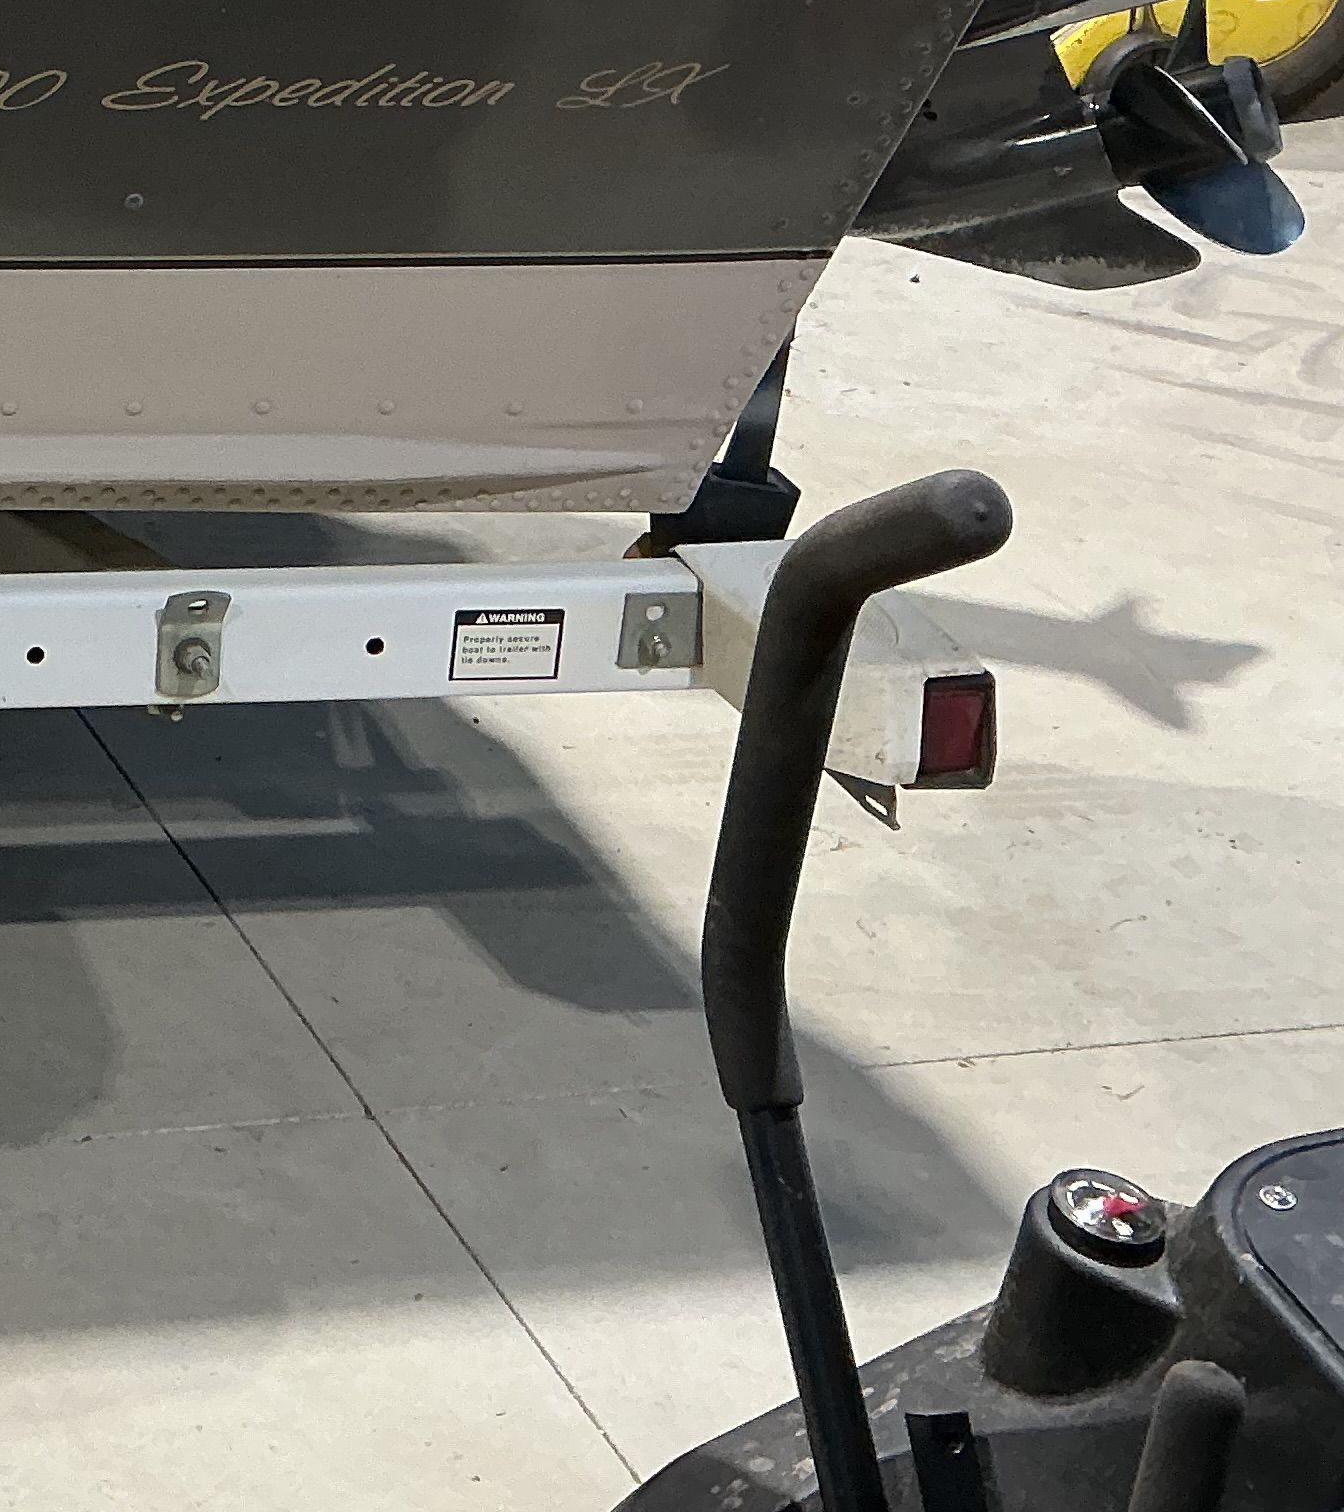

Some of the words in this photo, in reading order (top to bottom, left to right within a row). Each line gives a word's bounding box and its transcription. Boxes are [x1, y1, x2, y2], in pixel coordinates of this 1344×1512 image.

[100, 60, 516, 121] Expedition
[555, 61, 731, 110] LX
[489, 613, 545, 623] WARNING
[463, 635, 504, 644] Properly
[462, 646, 483, 654] boat
